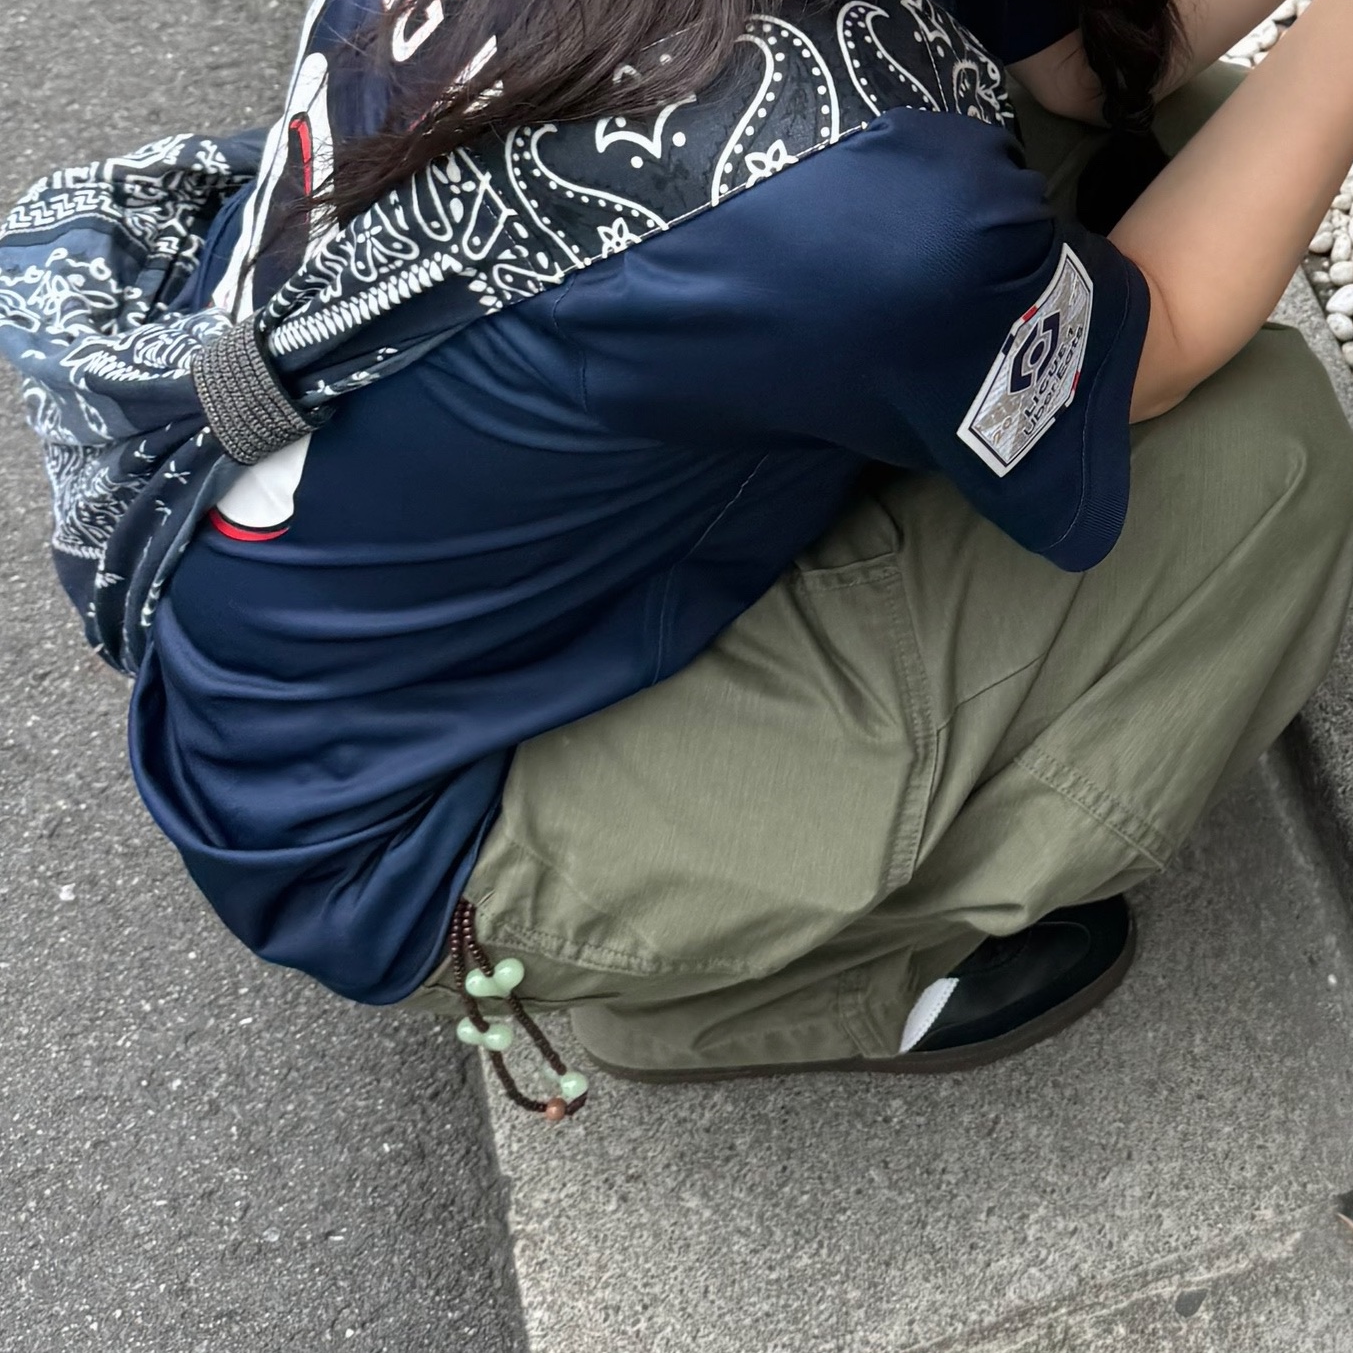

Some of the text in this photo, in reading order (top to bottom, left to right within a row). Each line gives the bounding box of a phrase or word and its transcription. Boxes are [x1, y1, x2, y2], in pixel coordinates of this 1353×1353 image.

[1023, 342, 1066, 418] LIGUE
[1023, 379, 1059, 435] Uber
[1056, 325, 1083, 382] Eats
